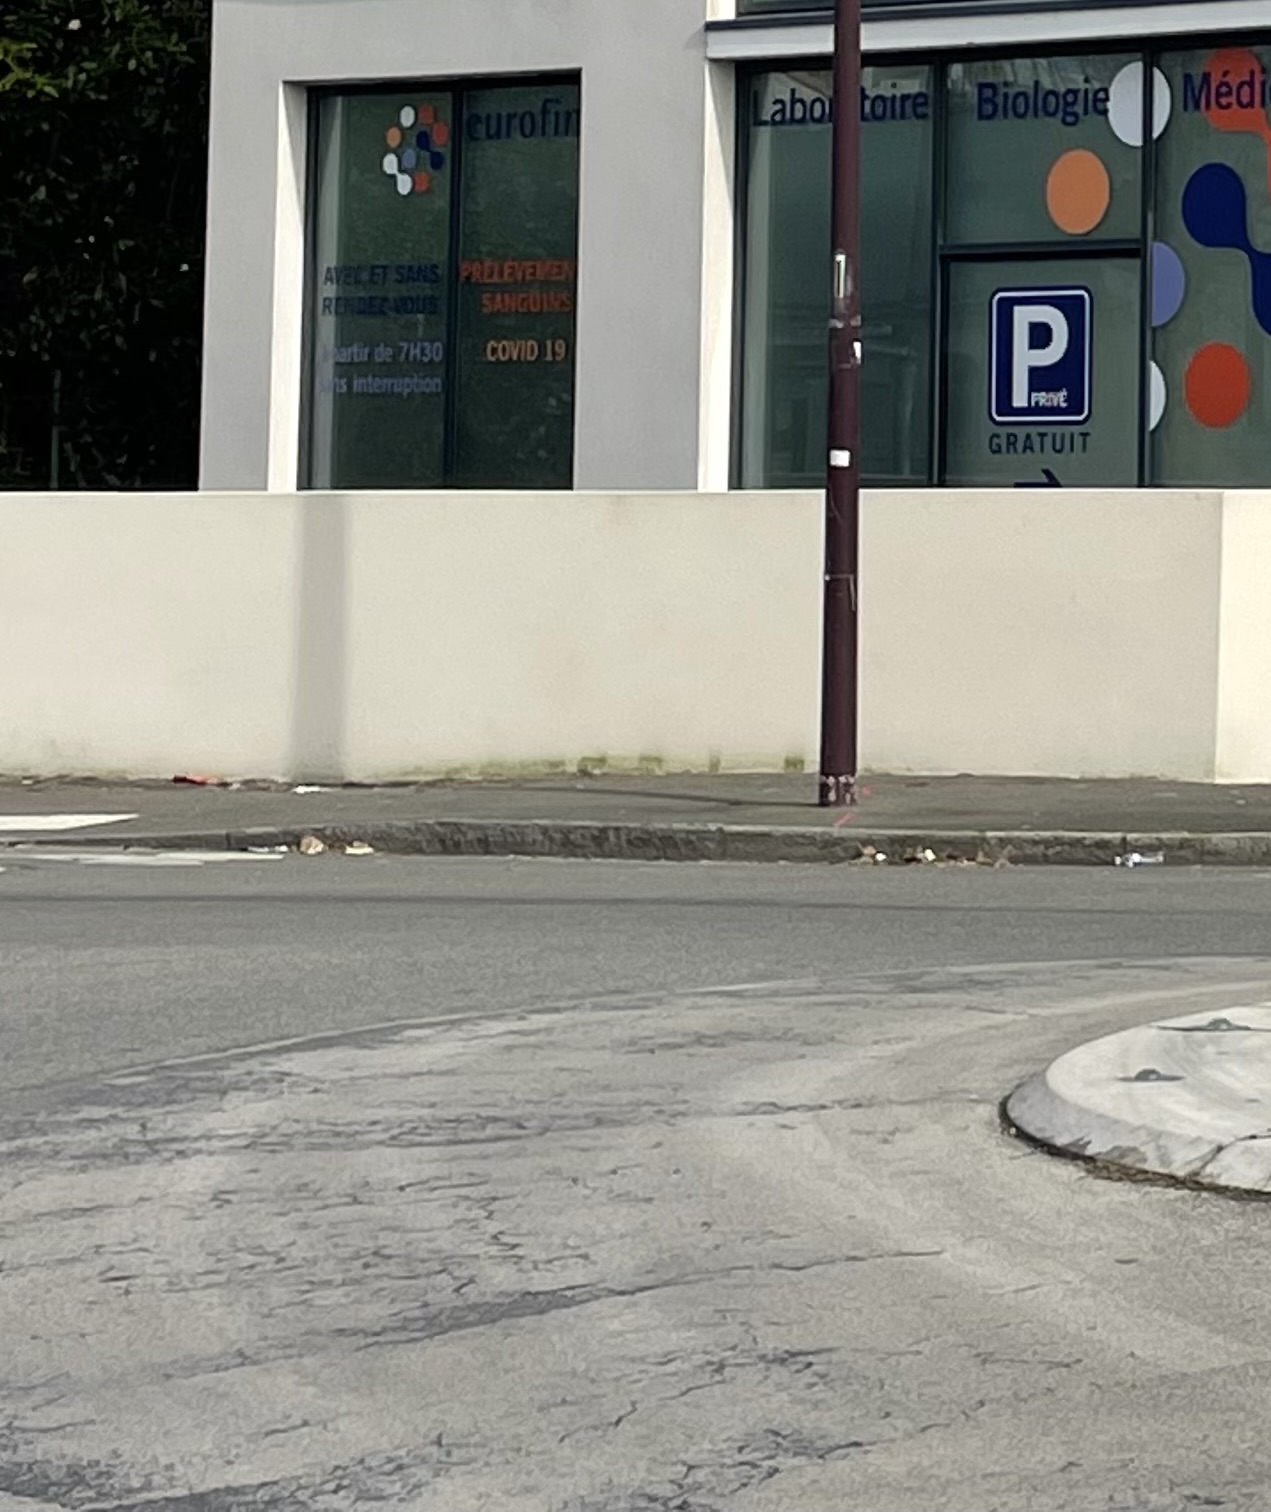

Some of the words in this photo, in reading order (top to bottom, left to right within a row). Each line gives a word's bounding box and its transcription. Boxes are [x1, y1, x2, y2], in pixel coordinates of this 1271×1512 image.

[752, 82, 929, 126] Labotoire
[976, 76, 1110, 126] Biologie
[394, 263, 440, 284] SANS
[480, 290, 573, 313] SANGUINS
[374, 342, 393, 363] de
[398, 341, 444, 363] 7H30
[485, 340, 539, 362] COVID
[544, 339, 567, 361] 19
[1012, 305, 1070, 408] P
[352, 373, 442, 398] interruption
[1031, 388, 1069, 409] PRIVÉ
[988, 432, 1092, 455] GRATUIT
